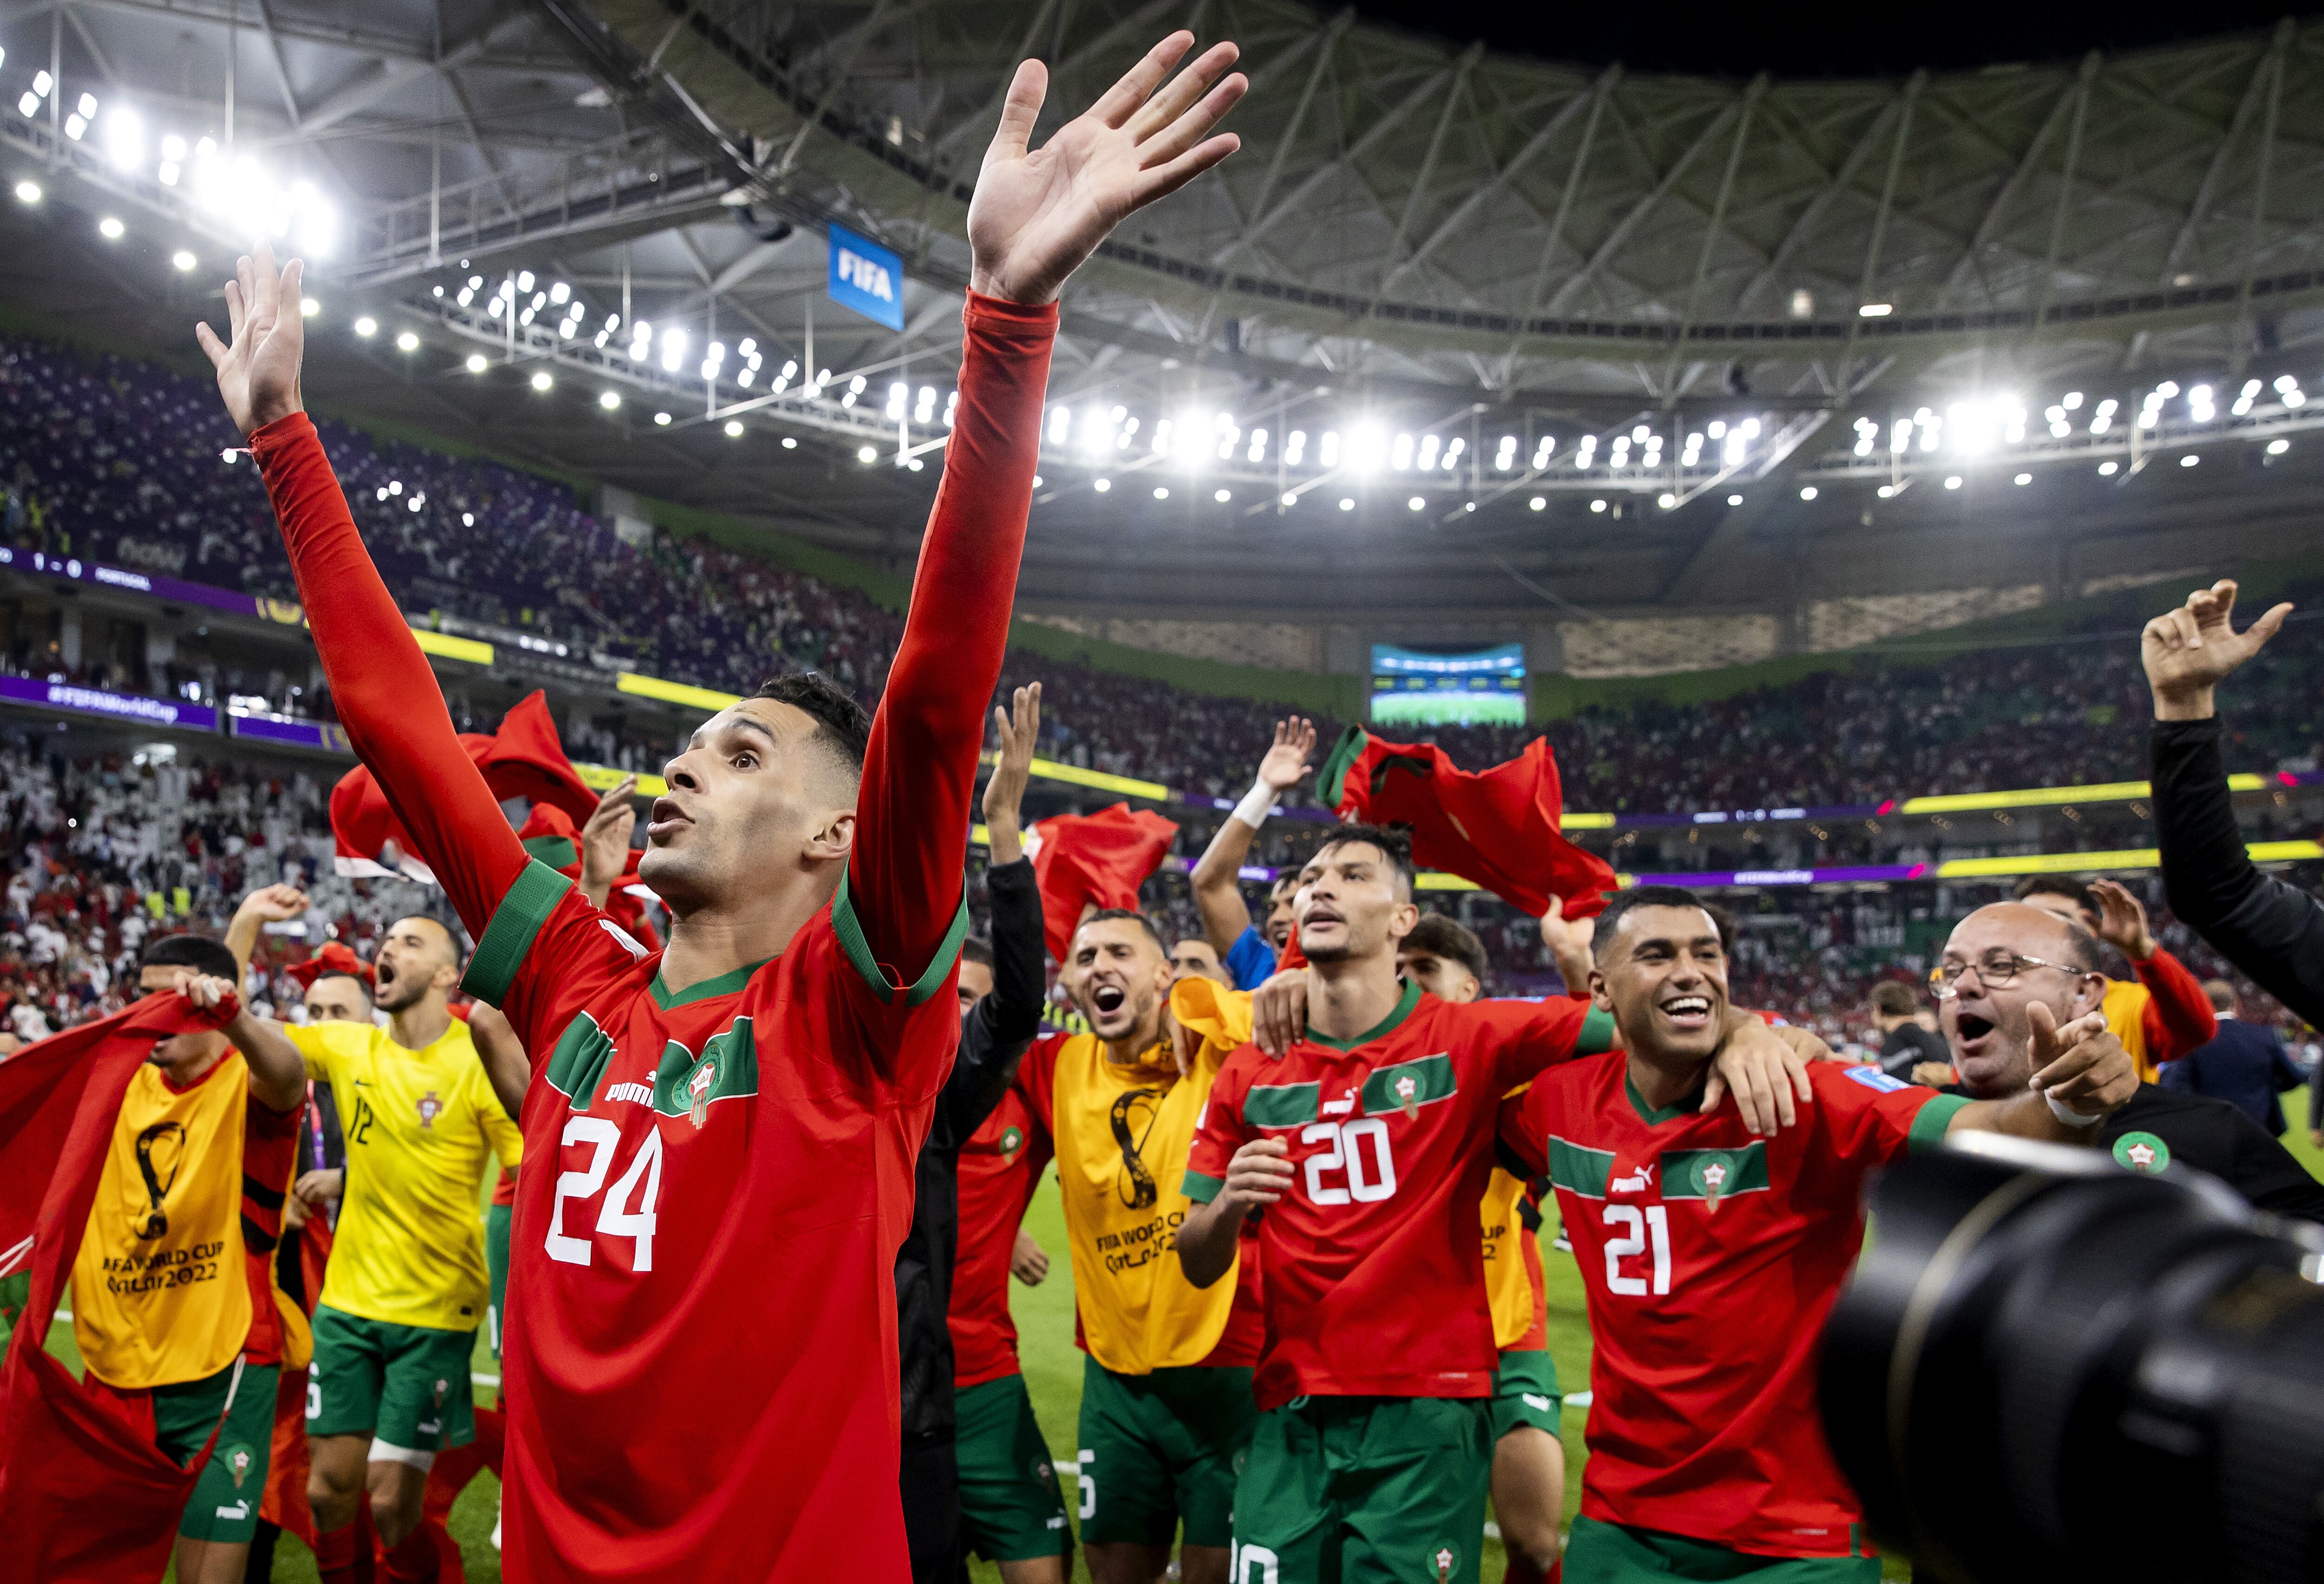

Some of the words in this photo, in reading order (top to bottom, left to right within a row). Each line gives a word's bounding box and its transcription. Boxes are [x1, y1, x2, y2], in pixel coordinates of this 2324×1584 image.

[838, 247, 893, 303] FIFA
[349, 1097, 372, 1145] 12
[544, 1116, 662, 1272] 24
[1301, 1118, 1397, 1206] 20
[192, 1241, 224, 1260] CUP
[1602, 1204, 1672, 1296] 21
